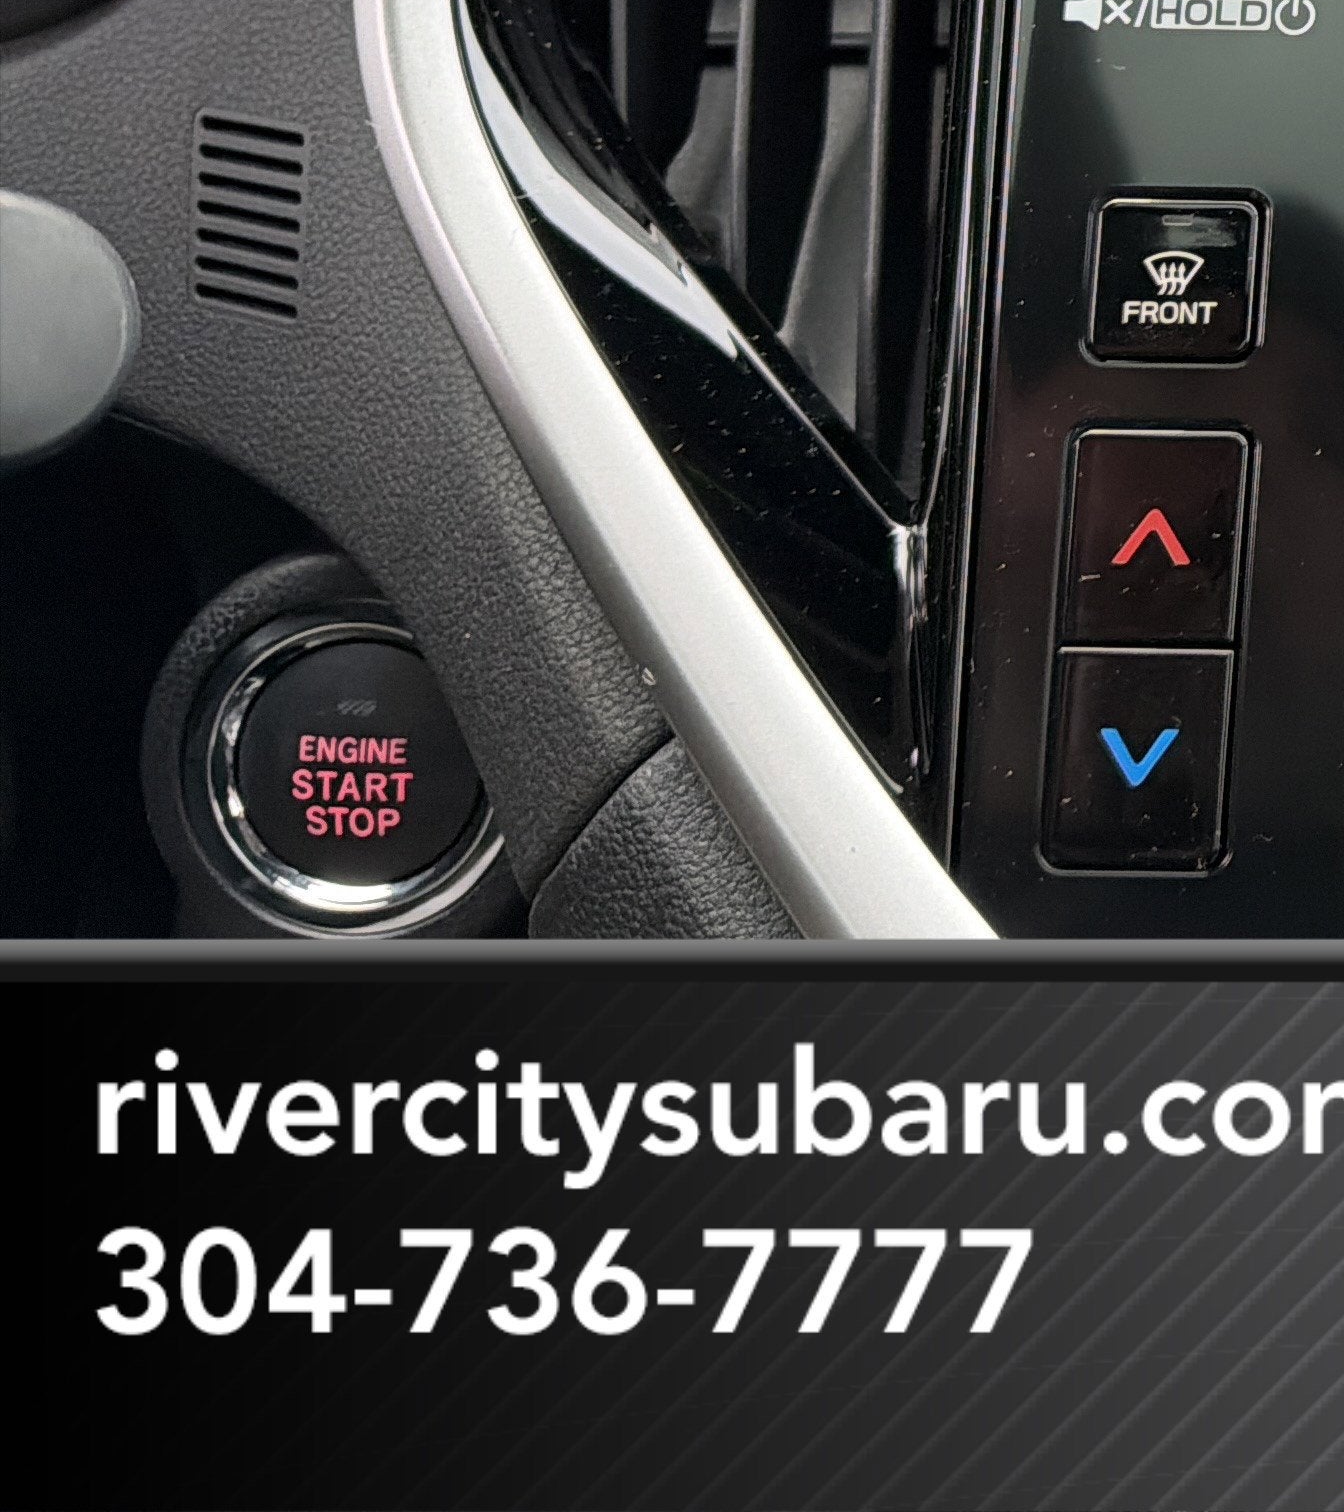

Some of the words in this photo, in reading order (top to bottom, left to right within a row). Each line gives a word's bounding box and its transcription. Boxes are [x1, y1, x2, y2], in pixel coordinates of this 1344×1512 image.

[1121, 300, 1219, 326] FRONT
[299, 735, 408, 765] ENGINE
[291, 769, 414, 802] START
[305, 805, 401, 838] STOP
